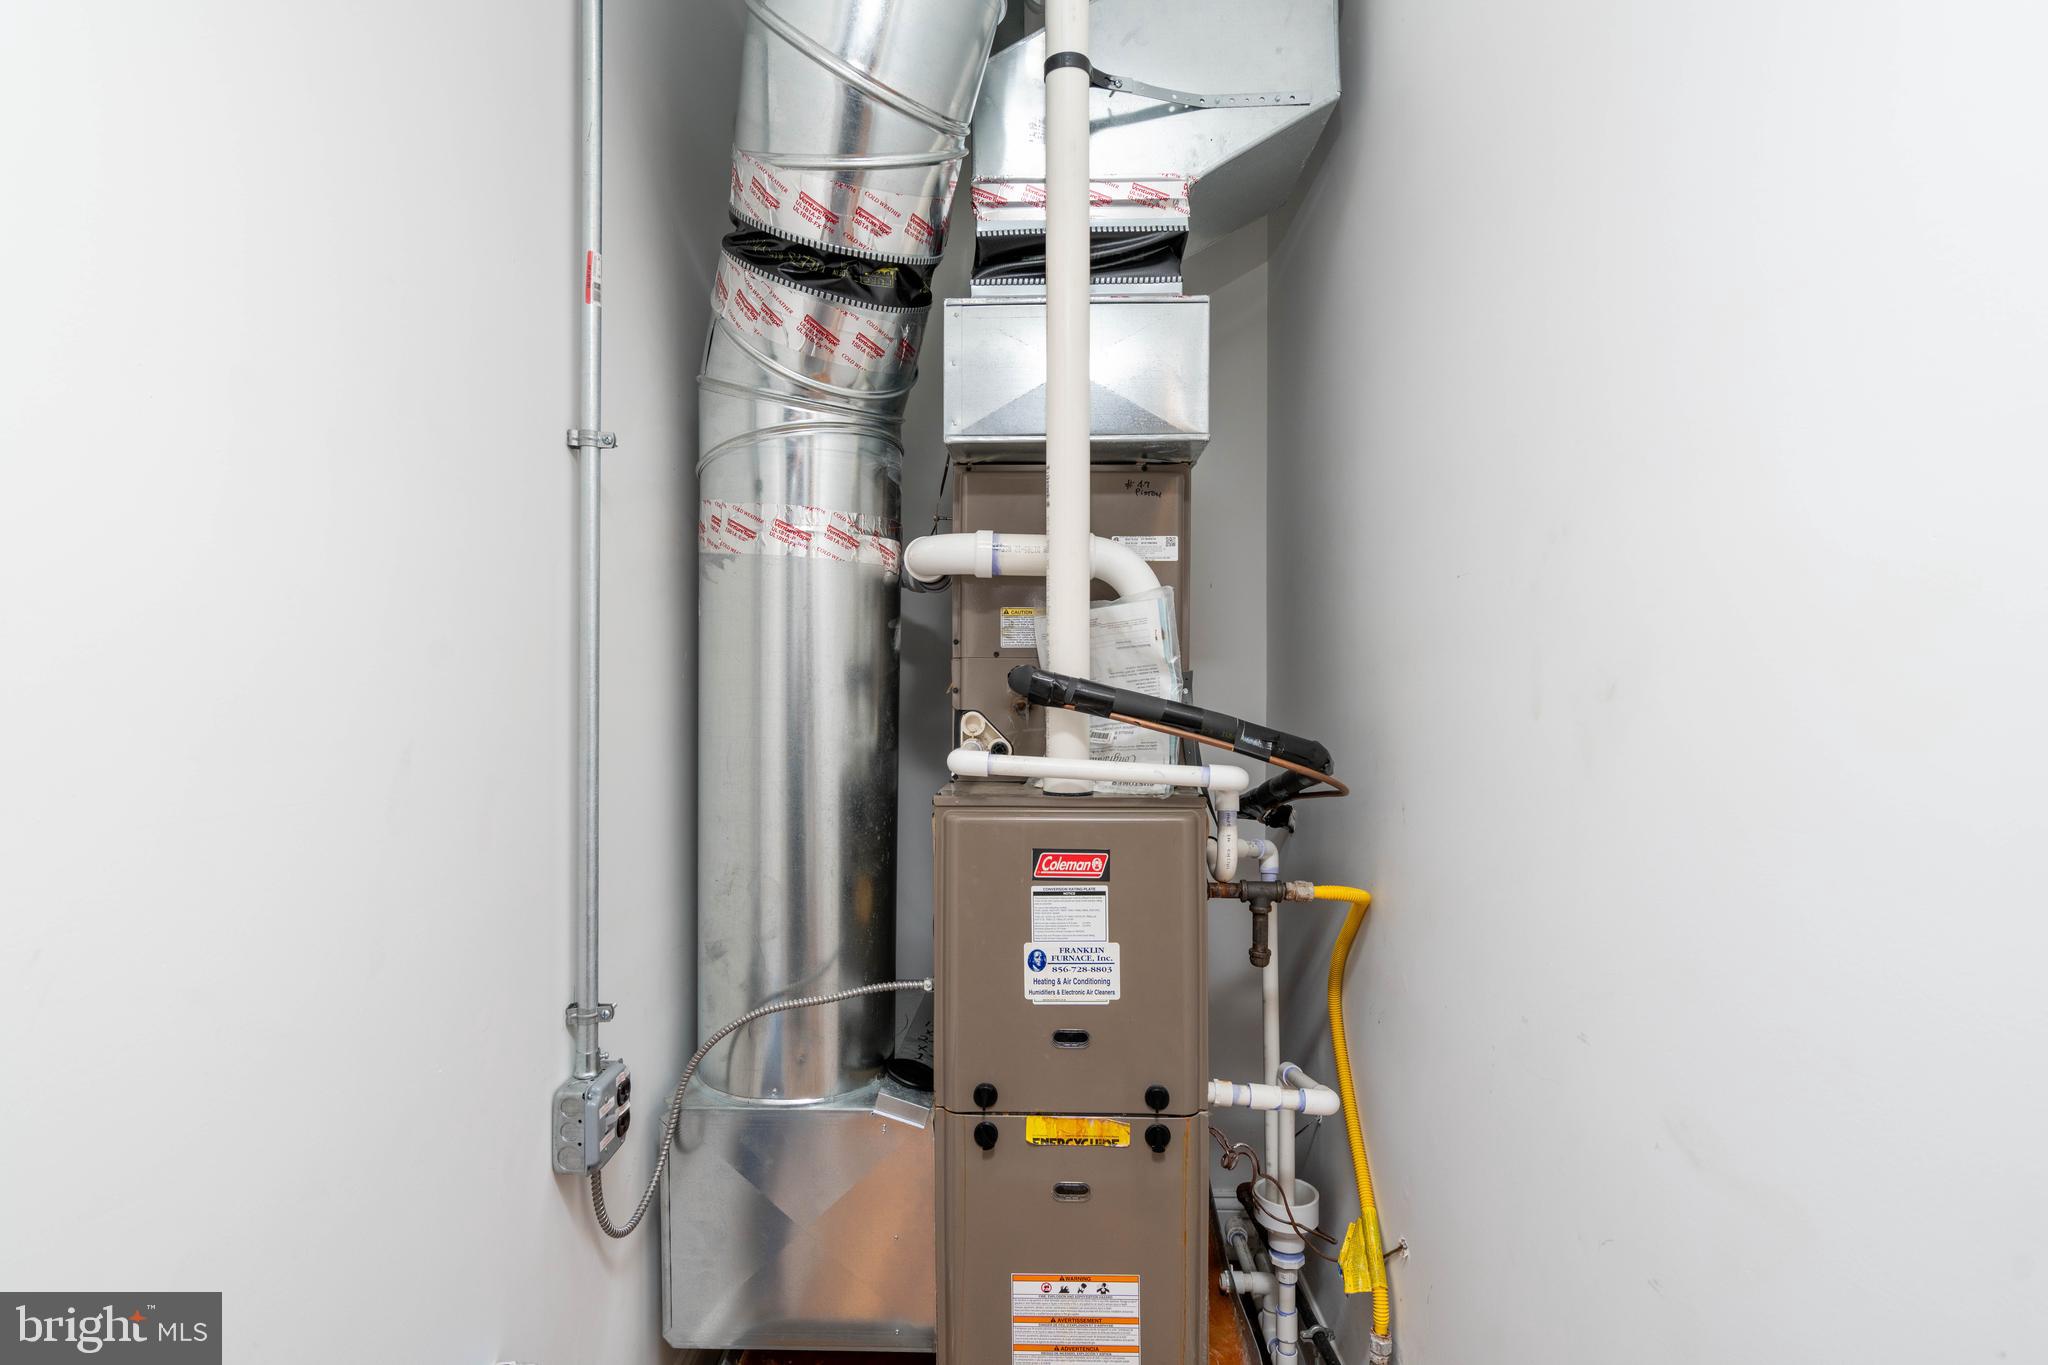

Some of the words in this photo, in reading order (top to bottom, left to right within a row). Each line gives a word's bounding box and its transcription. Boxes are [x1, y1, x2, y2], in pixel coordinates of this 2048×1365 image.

[1041, 855, 1091, 872] Coleman
[1033, 977, 1056, 986] Heating
[1056, 977, 1062, 985] &
[1063, 977, 1072, 985] Air
[1072, 977, 1111, 986] Conditioning
